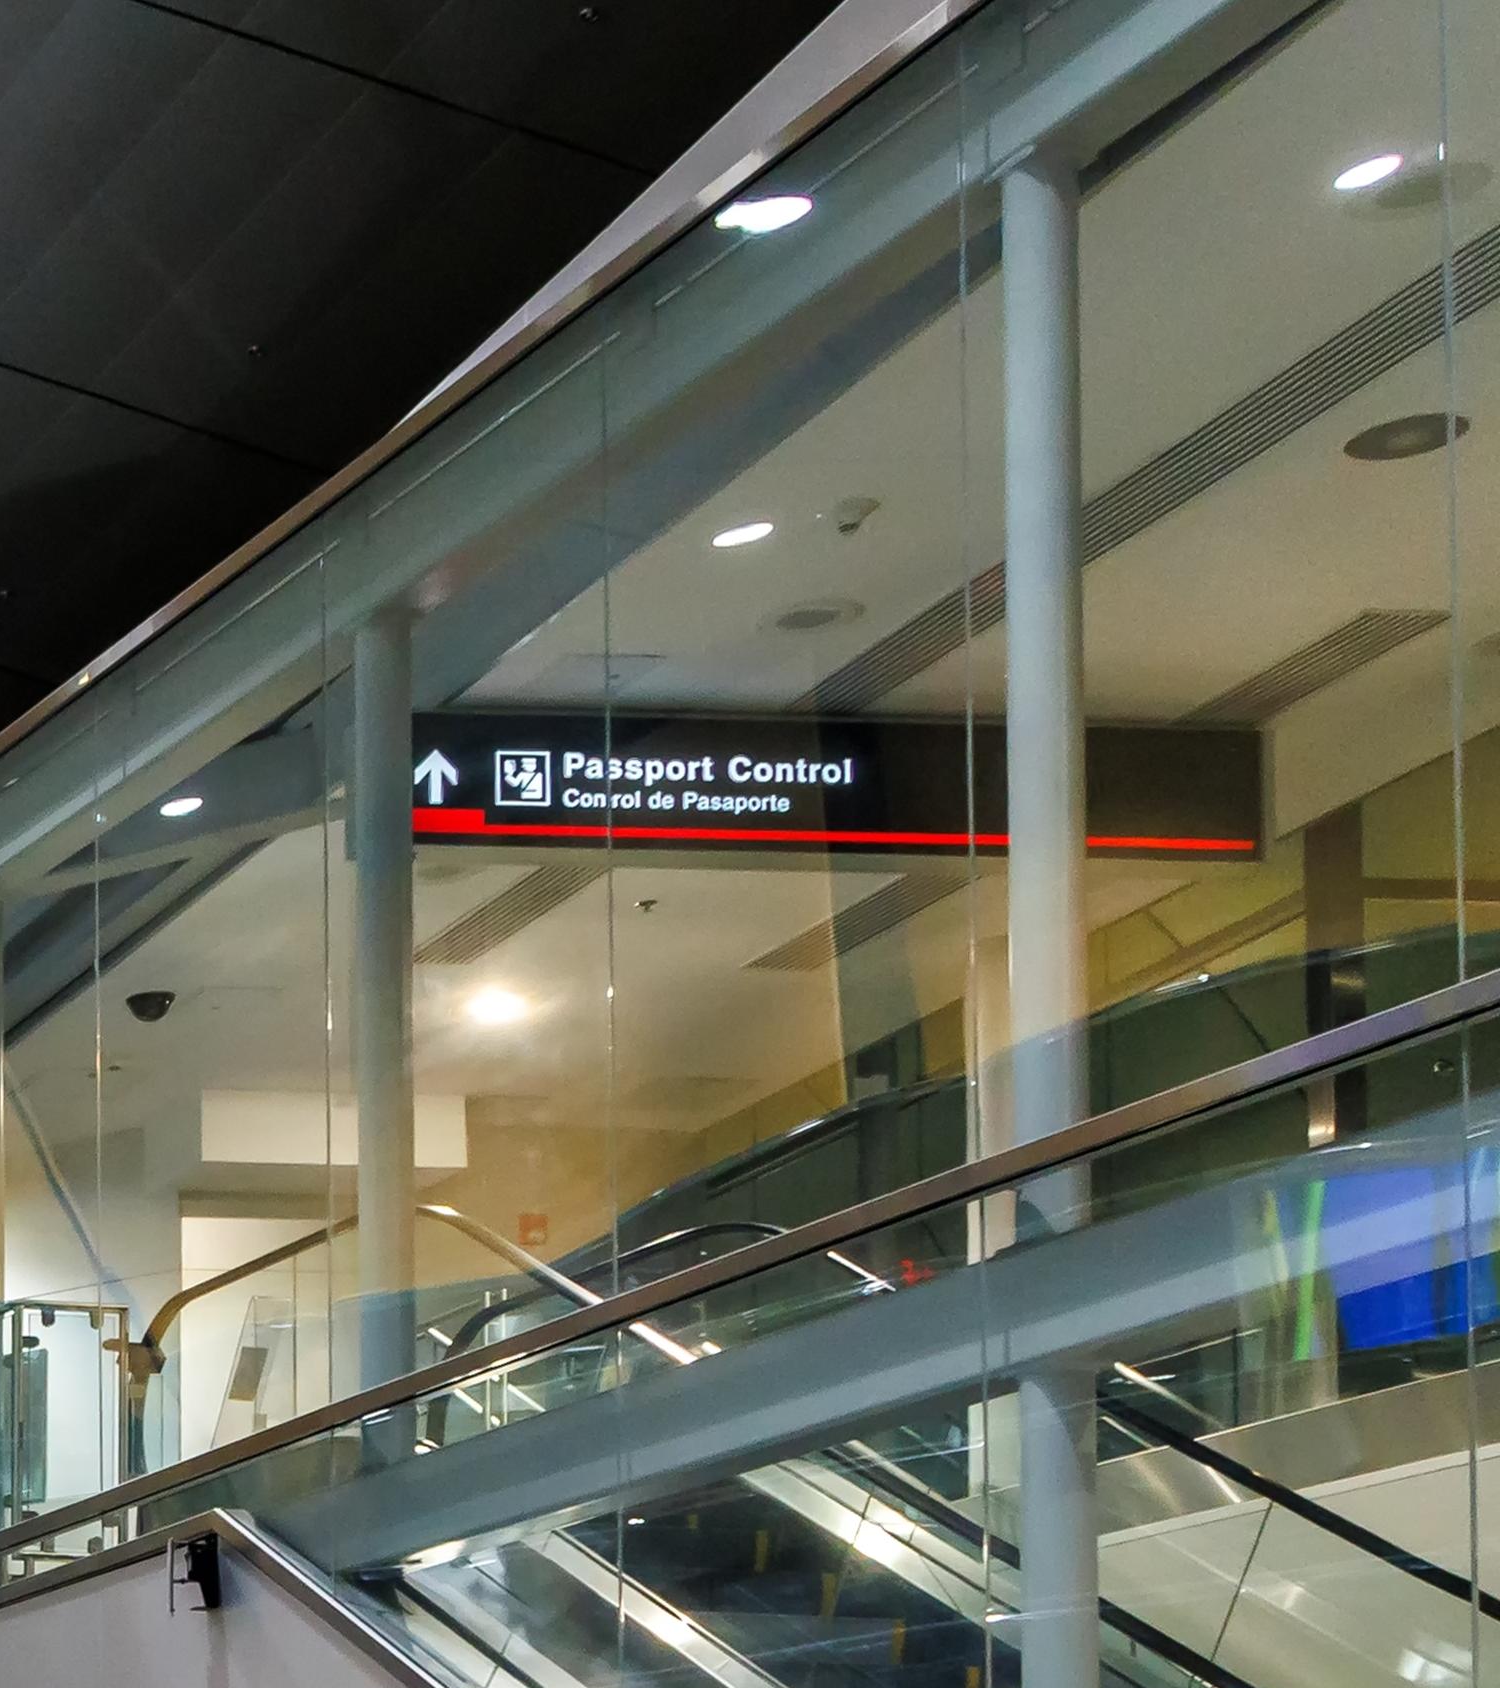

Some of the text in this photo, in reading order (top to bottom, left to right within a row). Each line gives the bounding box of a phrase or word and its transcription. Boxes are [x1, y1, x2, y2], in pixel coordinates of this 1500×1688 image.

[562, 752, 852, 785] Passport Control
[562, 788, 791, 815] Conrol de Pasaporte
